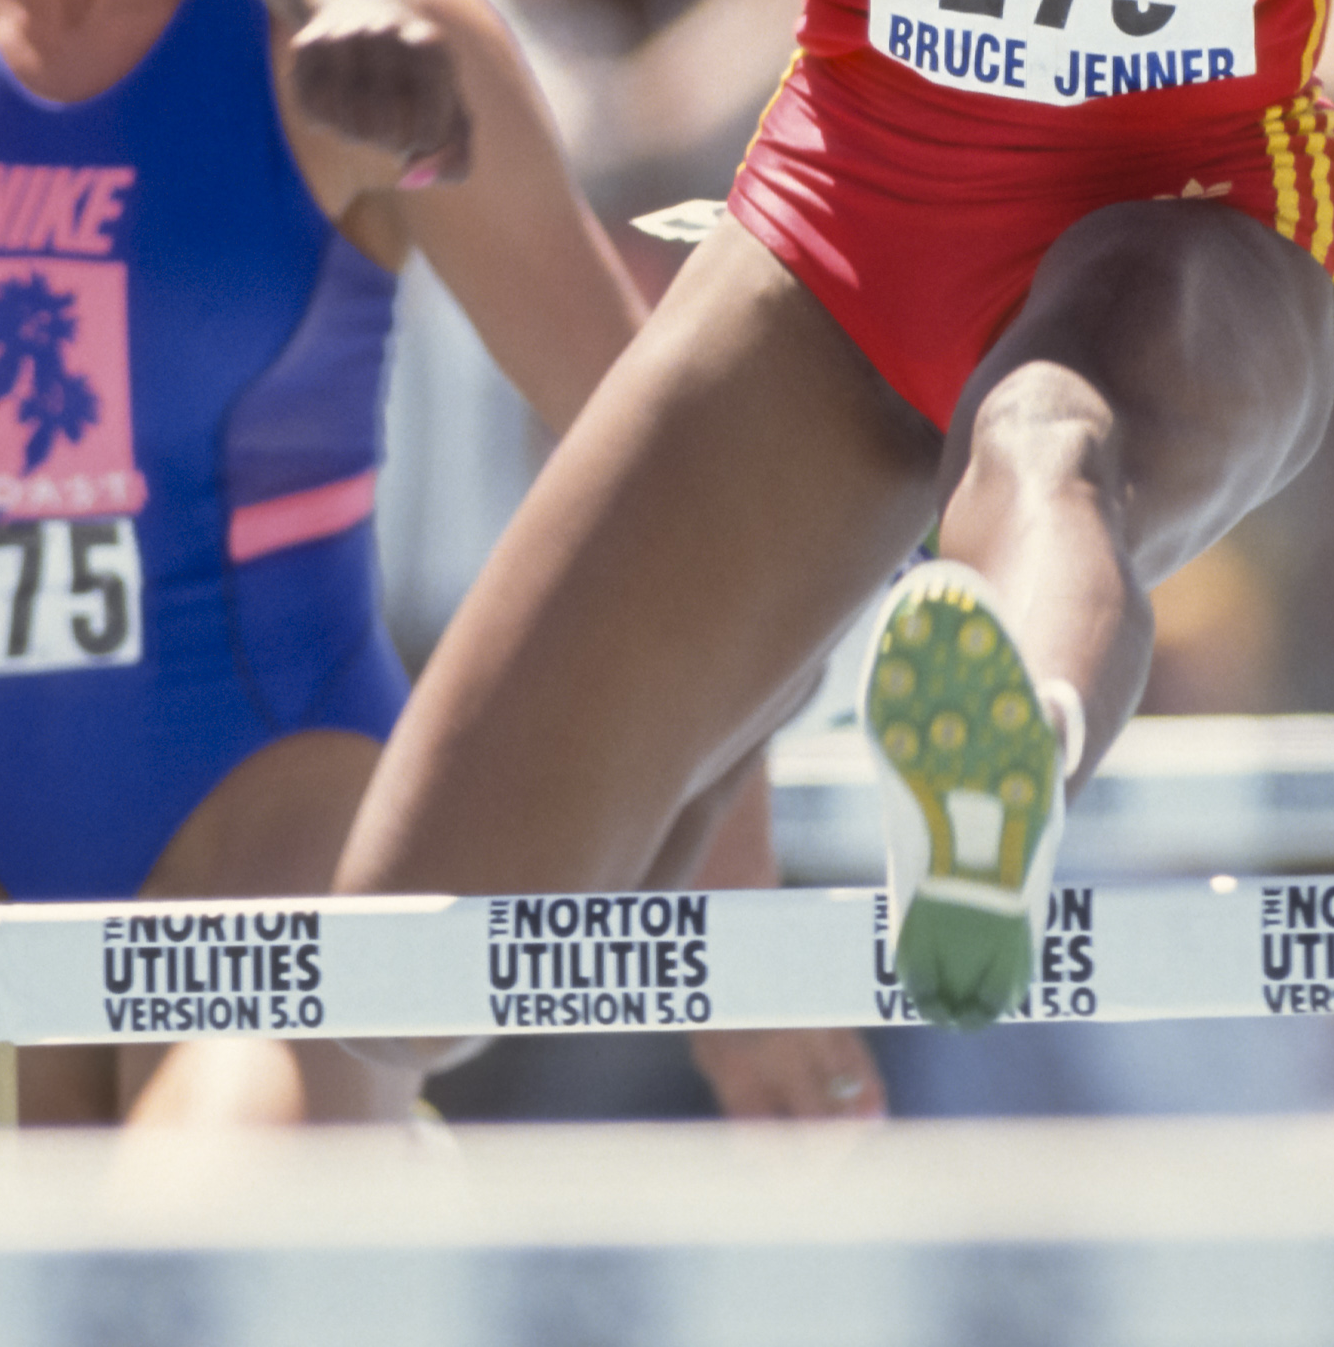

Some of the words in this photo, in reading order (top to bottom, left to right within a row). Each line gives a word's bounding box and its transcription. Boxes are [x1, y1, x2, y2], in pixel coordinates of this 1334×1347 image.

[889, 14, 1027, 88] BRUCE
[1054, 47, 1235, 98] JENNER
[489, 900, 510, 939] THE
[514, 895, 708, 938] NORTON
[1263, 887, 1283, 928] THE
[104, 916, 124, 942] TH
[104, 944, 322, 994] UTILITIES
[489, 940, 708, 991] UTILITIES
[104, 995, 260, 1032] VERSION
[271, 995, 325, 1029] 5.0
[489, 992, 646, 1027] VERSION
[656, 991, 711, 1025] 5.0
[1042, 986, 1097, 1018] 5.0
